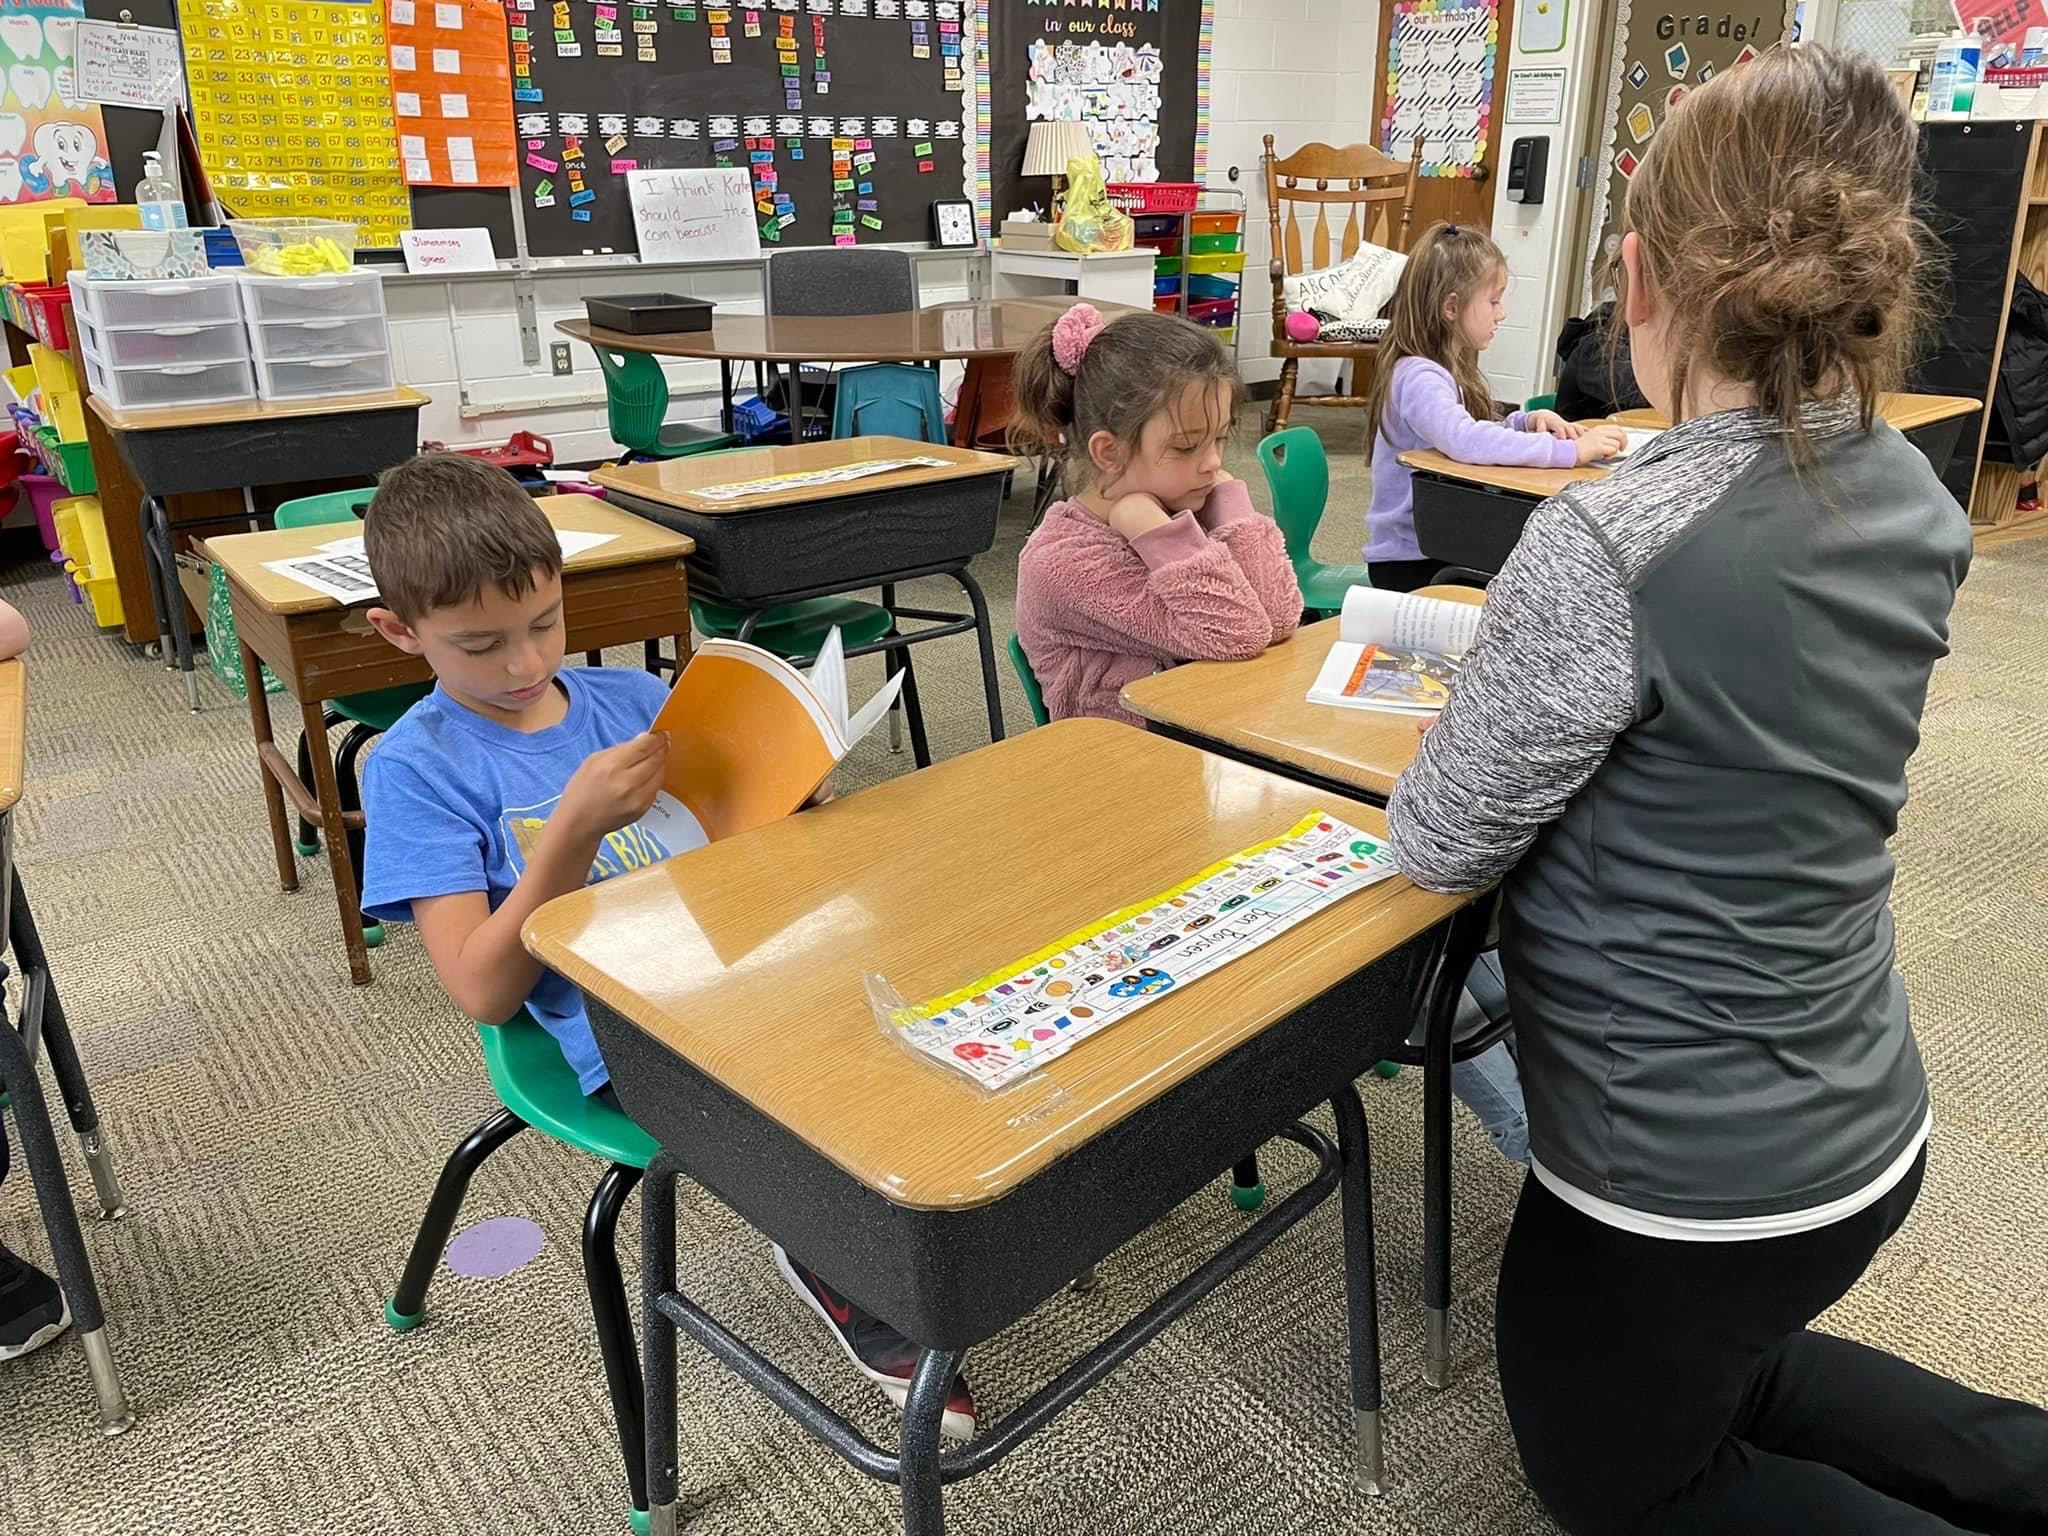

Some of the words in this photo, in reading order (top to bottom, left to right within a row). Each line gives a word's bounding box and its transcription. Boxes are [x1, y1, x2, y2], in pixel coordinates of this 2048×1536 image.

[558, 31, 573, 40] but
[1045, 18, 1061, 32] in
[1069, 20, 1095, 32] our
[1100, 14, 1136, 37] class
[1656, 14, 1761, 41] Grade!
[640, 178, 664, 195] I
[672, 176, 714, 197] think
[722, 173, 751, 196] Kate
[640, 205, 680, 221] should
[721, 200, 753, 219] the
[674, 223, 719, 240] because
[1234, 908, 1281, 925] Ben
[1177, 928, 1247, 958] Boysen
